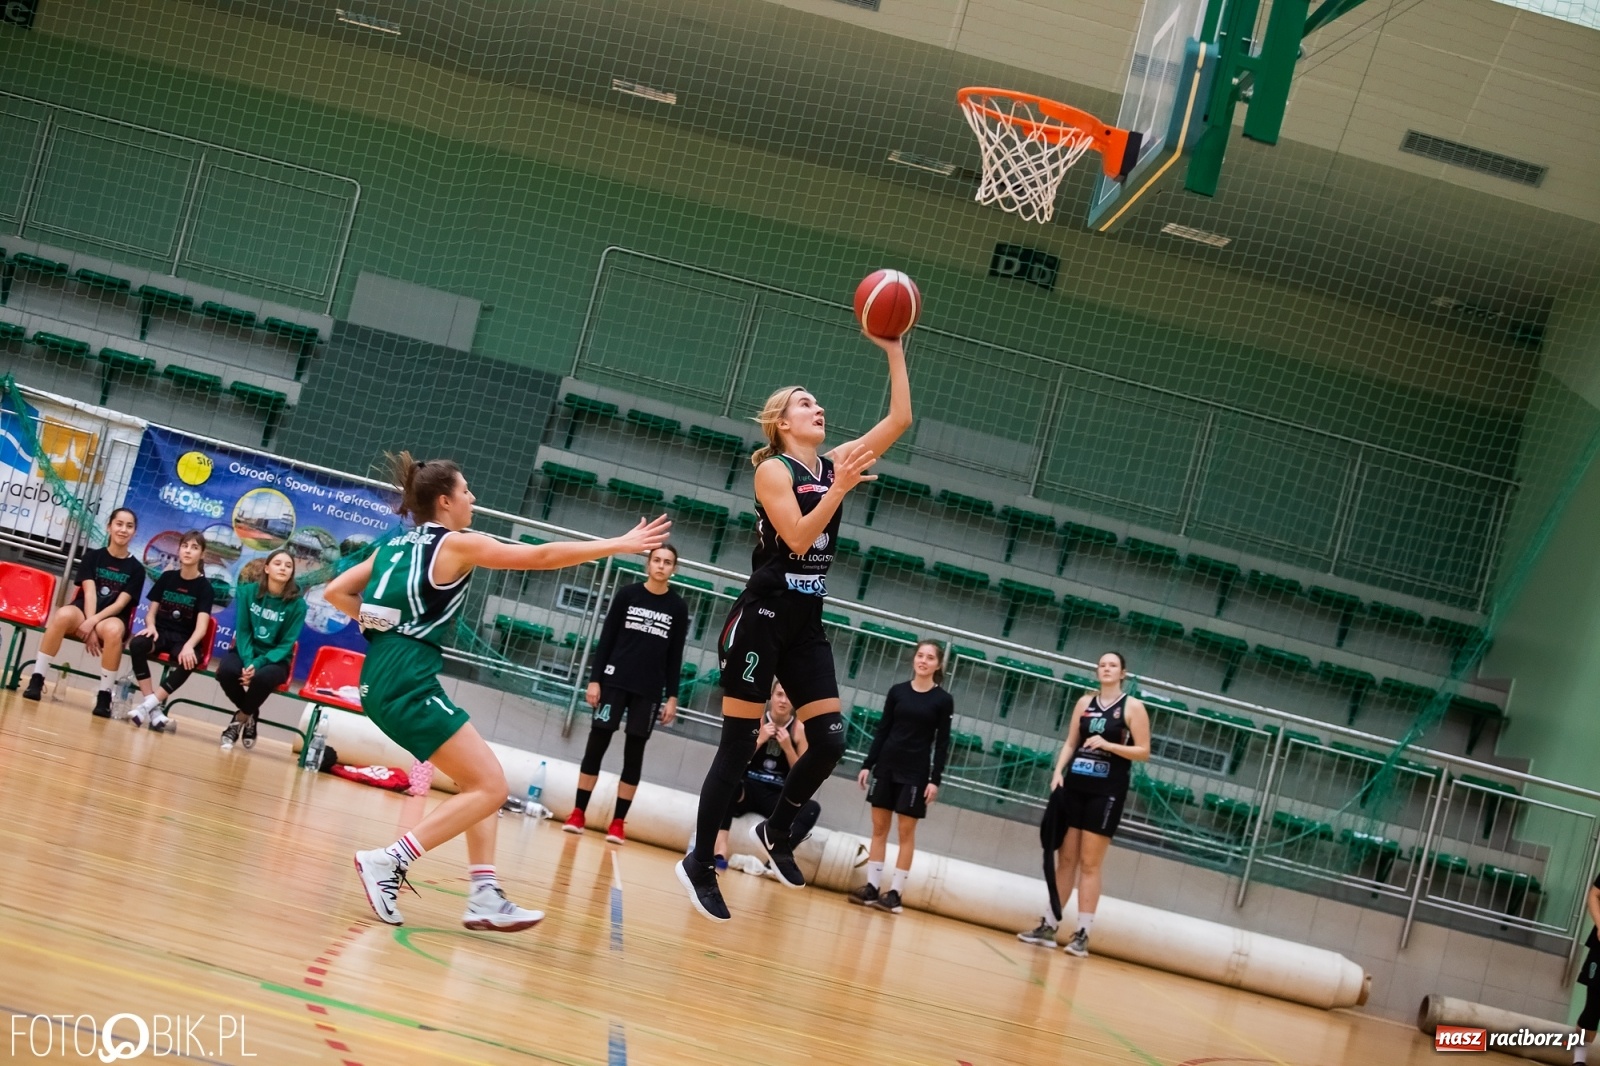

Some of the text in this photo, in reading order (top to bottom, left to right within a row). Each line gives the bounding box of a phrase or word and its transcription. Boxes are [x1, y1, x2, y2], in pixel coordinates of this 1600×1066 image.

[229, 462, 282, 485] Ośrodek
[284, 476, 326, 498] Sportu
[311, 502, 389, 531] w Raciborzu
[373, 550, 405, 600] 1
[624, 620, 669, 639] BASKETBALL
[626, 605, 674, 626] SOSNOWIEC
[742, 651, 760, 683] 2
